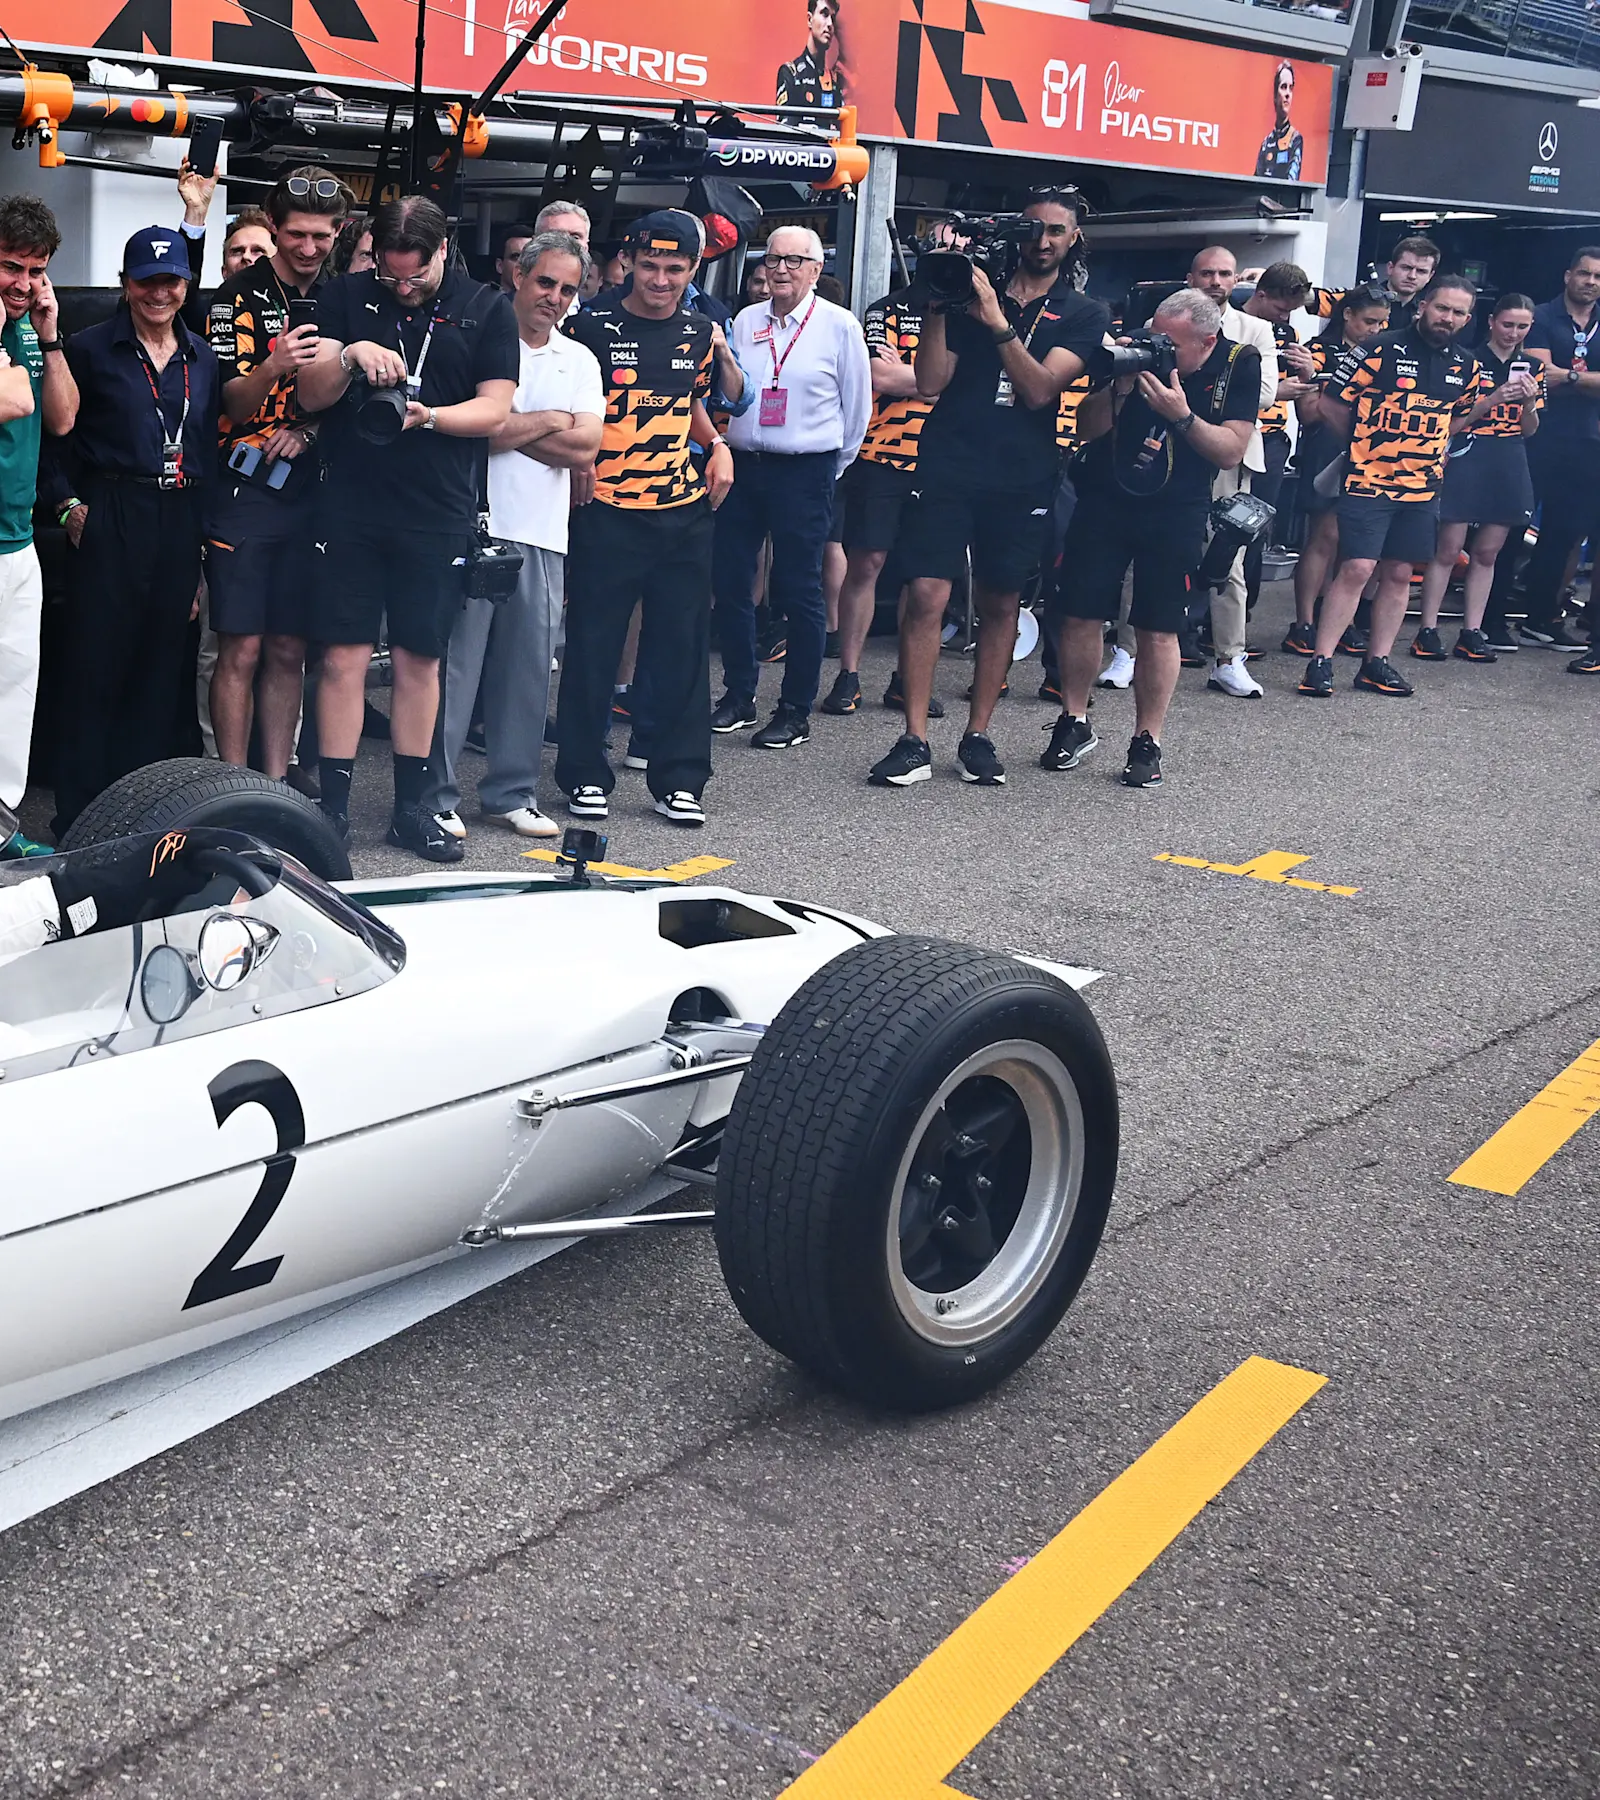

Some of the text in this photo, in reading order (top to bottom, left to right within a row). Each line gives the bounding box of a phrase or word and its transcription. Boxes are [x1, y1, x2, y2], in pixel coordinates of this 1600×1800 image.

[503, 0, 567, 33] Lano
[505, 28, 708, 87] NORRIS
[1041, 58, 1087, 131] 81
[1103, 60, 1145, 108] Oscar
[1100, 108, 1219, 148] PIASTRI
[741, 147, 833, 169] DP WORLD
[211, 321, 233, 333] okta
[866, 321, 885, 331] okta
[611, 351, 639, 361] DELL
[671, 359, 695, 370] OKX
[1396, 365, 1418, 374] DELL
[1215, 380, 1226, 401] NPS
[180, 1059, 306, 1311] 2
